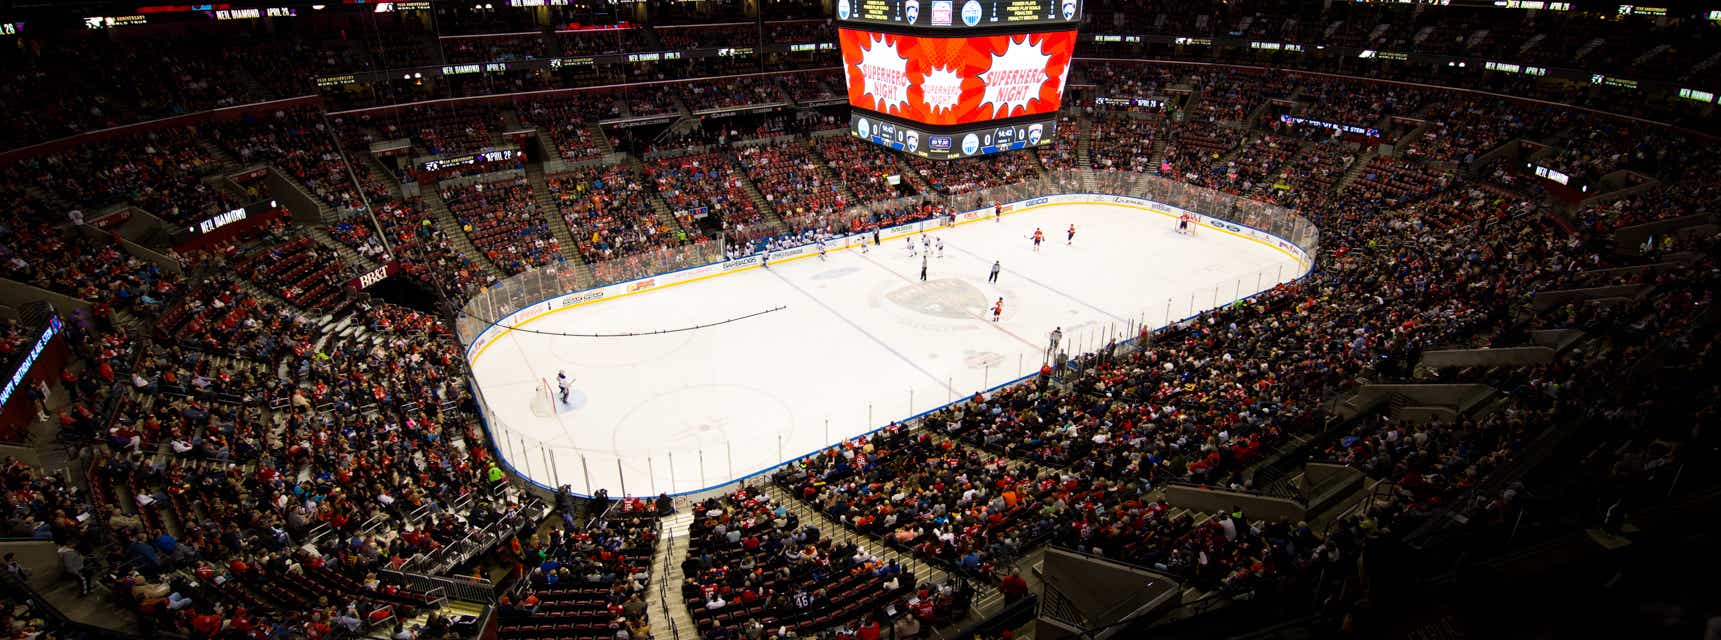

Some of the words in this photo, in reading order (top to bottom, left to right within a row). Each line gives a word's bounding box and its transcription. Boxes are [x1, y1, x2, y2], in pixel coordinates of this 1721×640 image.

[216, 11, 231, 20] NEIL
[231, 9, 260, 19] DIAMOND
[267, 8, 281, 16] APRIL
[443, 66, 455, 75] NEIL
[455, 64, 480, 74] DIAMOND
[486, 63, 500, 71] APRIL
[863, 64, 907, 88] SUPERHERO
[986, 67, 1045, 87] SUPERHERO
[874, 83, 898, 101] NIGHT
[923, 84, 961, 96] SUPERHERO
[996, 84, 1030, 103] NIGHT
[931, 96, 951, 105] NIGHT
[873, 124, 878, 135] 0
[899, 130, 904, 142] 0
[985, 134, 991, 146] 0
[1019, 128, 1025, 140] 0
[486, 151, 503, 163] APRIL
[1025, 197, 1049, 207] GEICO
[200, 219, 215, 235] NEIL
[213, 208, 247, 228] DIAMOND
[359, 265, 389, 289] BB&T
[0, 379, 15, 408] HAPPY
[12, 354, 33, 387] BIRTHDAY
[31, 339, 45, 361] BLAKE
[796, 595, 809, 608] 46
